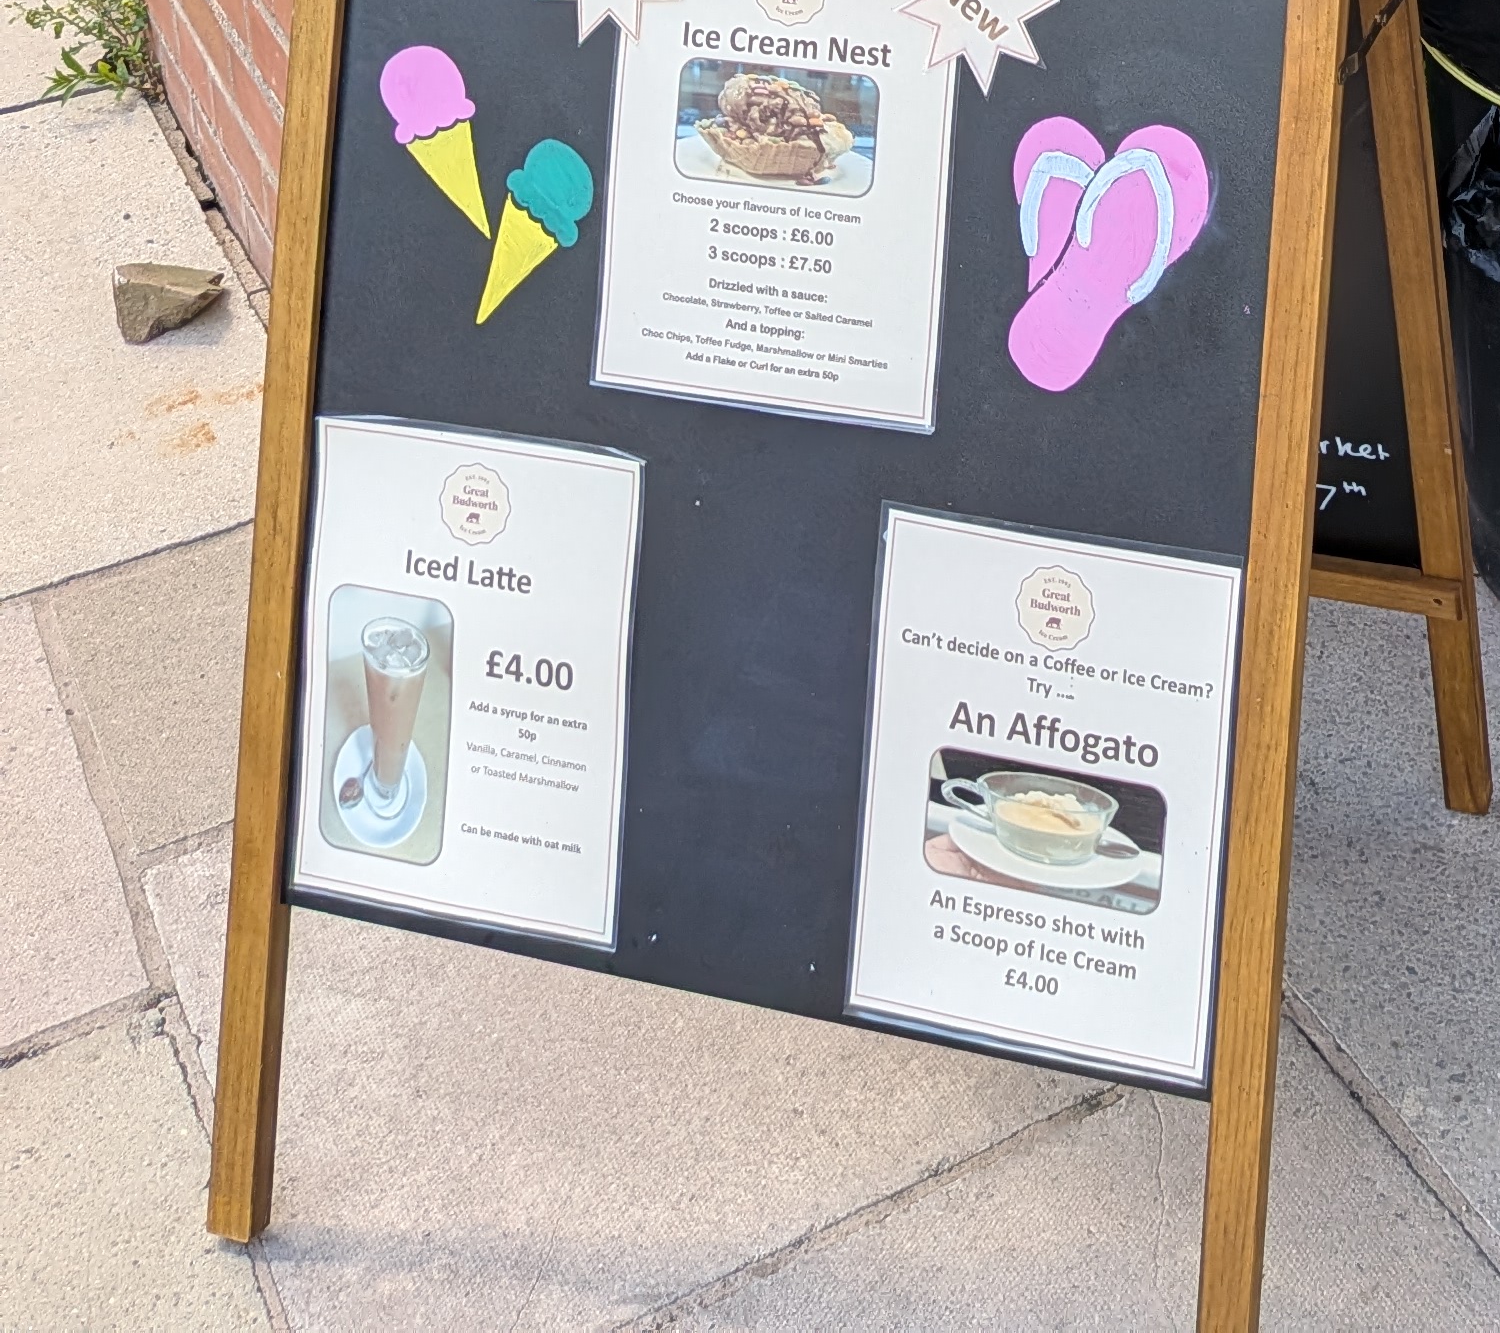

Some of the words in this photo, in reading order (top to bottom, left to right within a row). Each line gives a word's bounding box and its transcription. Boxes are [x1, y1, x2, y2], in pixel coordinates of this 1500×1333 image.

[682, 21, 721, 50] Ice
[729, 26, 818, 60] Cream
[828, 36, 892, 68] Nest
[672, 191, 714, 208] Choose
[716, 197, 740, 214] your
[742, 197, 787, 217] flavours
[789, 205, 802, 218] of
[804, 206, 822, 221] Ice
[824, 209, 862, 225] Cream
[709, 218, 720, 233] 2
[724, 222, 779, 243] scoops
[790, 227, 834, 247] £6.00
[708, 245, 718, 260] 3
[722, 248, 777, 269] scoops
[788, 255, 832, 274] £7.50
[405, 549, 459, 582] Iced
[467, 559, 532, 594] Latte
[485, 650, 574, 691] £4.00
[949, 701, 996, 738] An
[1006, 712, 1159, 768] Affogato
[461, 822, 478, 837] Can
[480, 825, 492, 839] be
[493, 827, 520, 844] made
[521, 832, 542, 848] with
[544, 837, 559, 851] oat
[561, 839, 582, 854] milk
[929, 889, 956, 911] An
[962, 895, 1047, 929] Espresso
[1051, 914, 1096, 940] shot
[1100, 927, 1145, 950] with
[1004, 968, 1059, 996] £4.00
